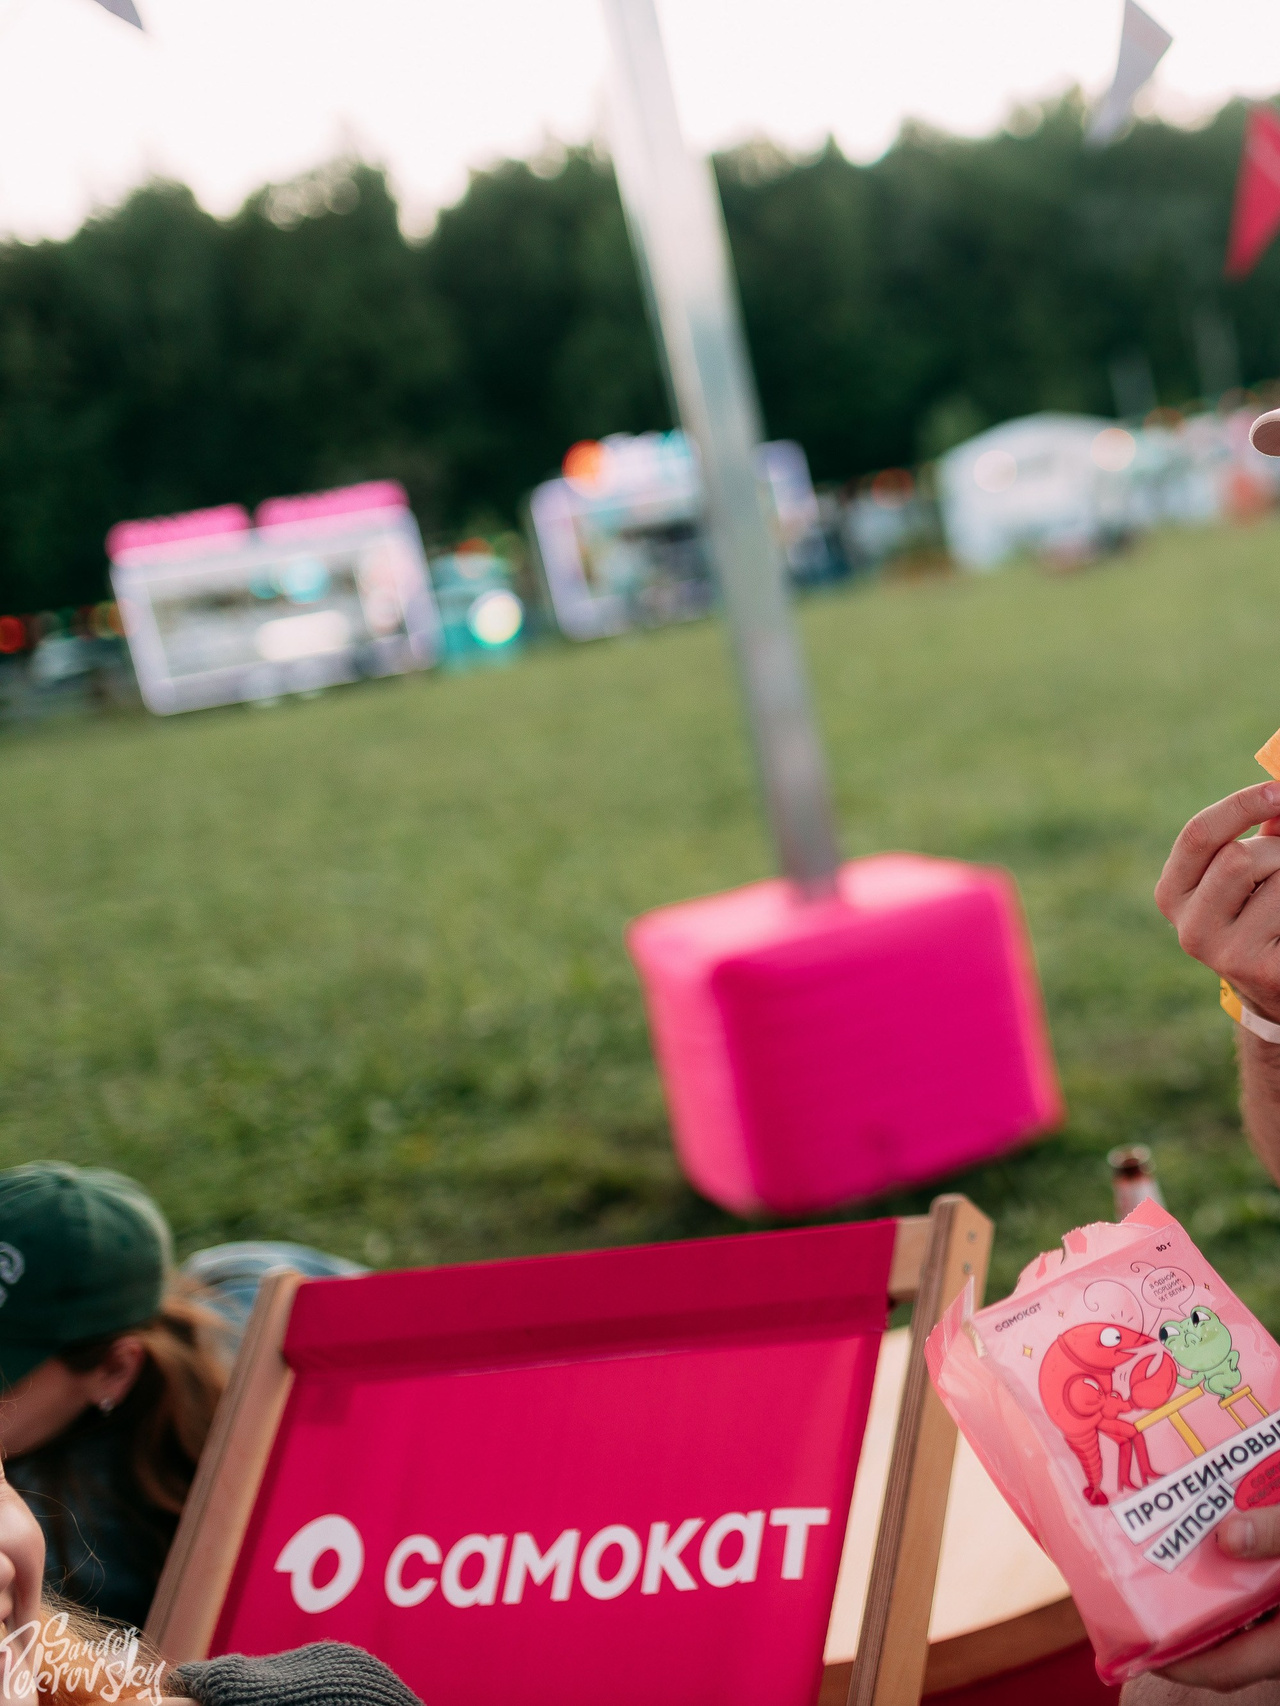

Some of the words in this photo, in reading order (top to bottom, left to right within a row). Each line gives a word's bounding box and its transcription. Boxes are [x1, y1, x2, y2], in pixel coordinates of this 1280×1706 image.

[1155, 1244, 1167, 1252] 80
[1154, 1271, 1176, 1286] ОДНОЙ
[1168, 1284, 1187, 1298] БЕЛКА
[1153, 1484, 1233, 1561] ЧИПСЫ
